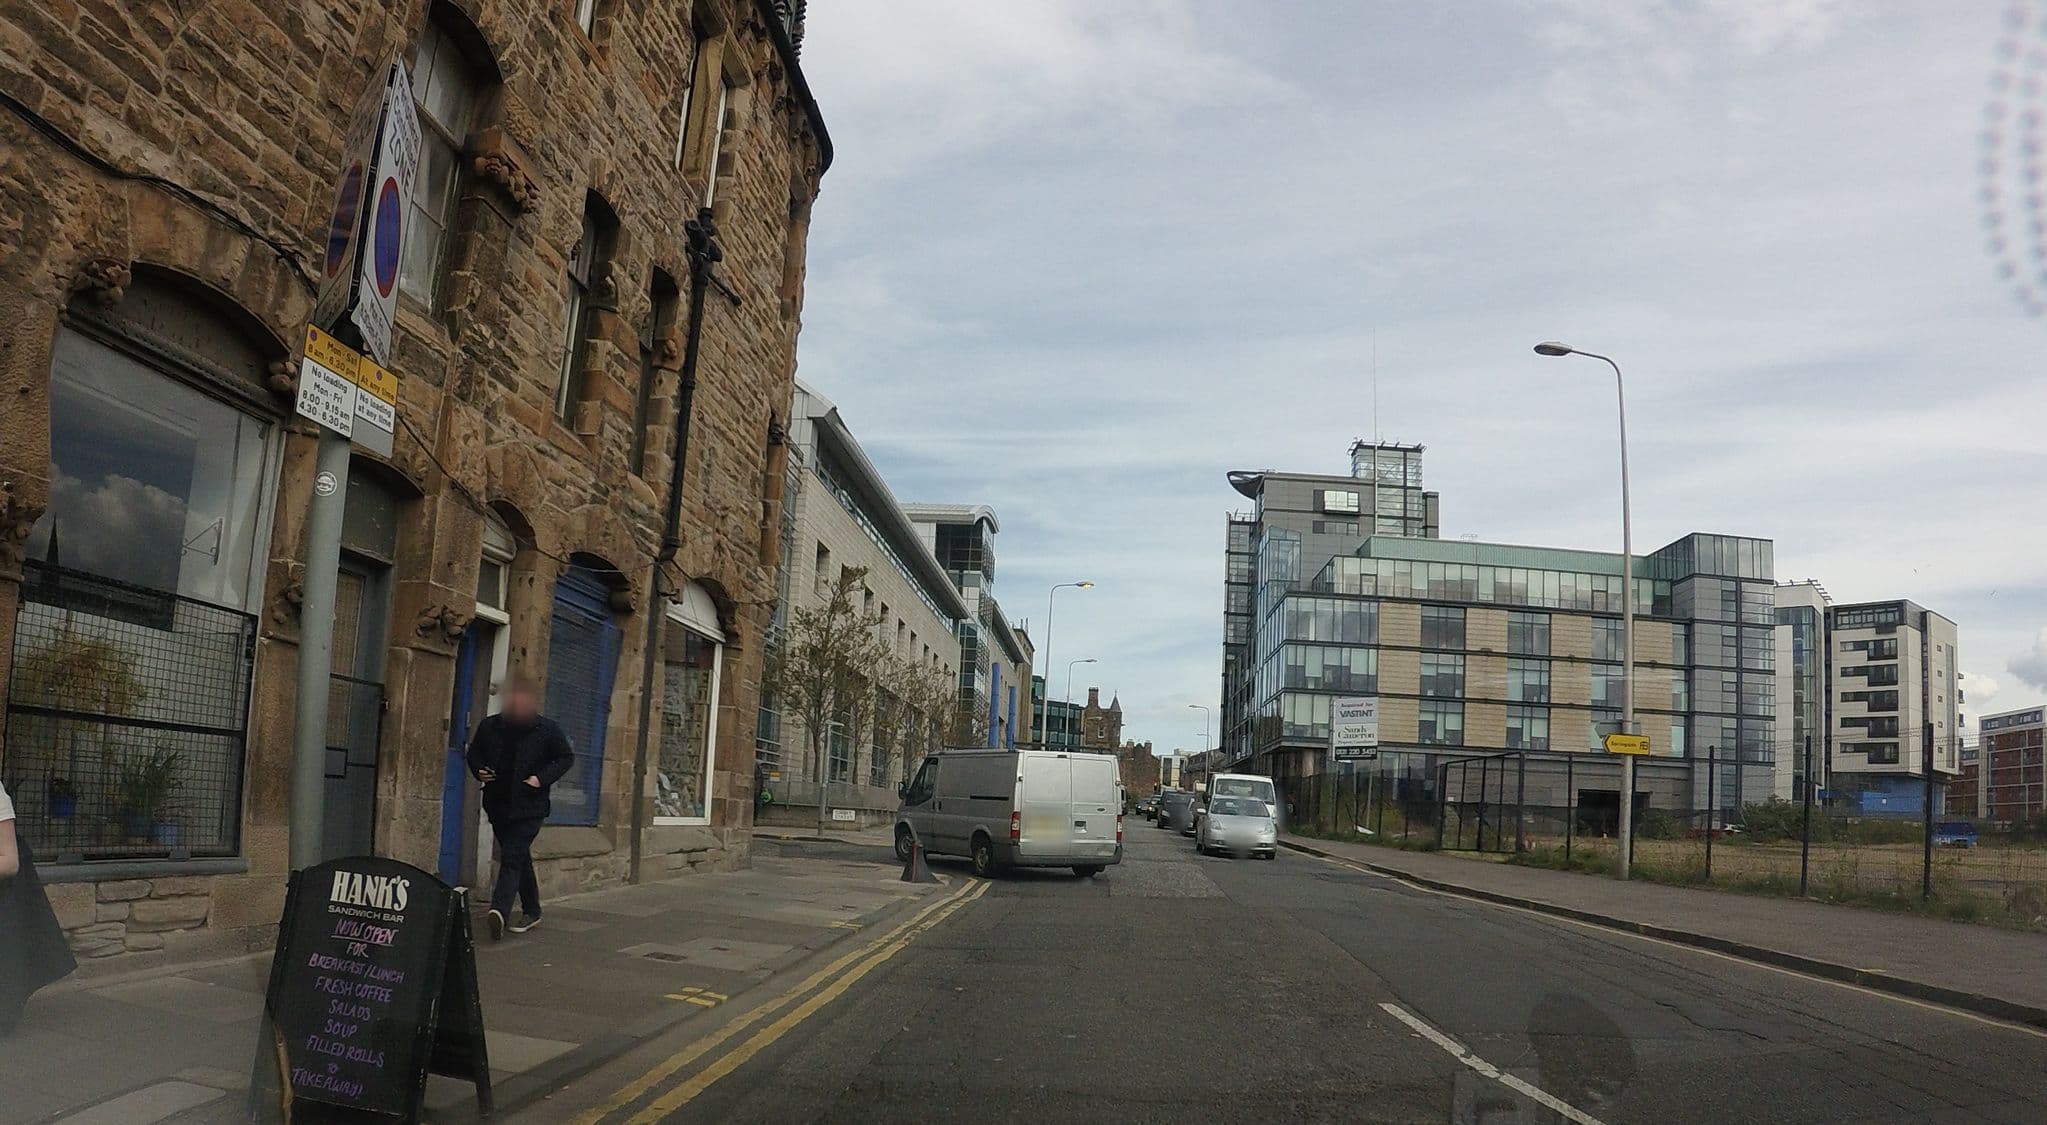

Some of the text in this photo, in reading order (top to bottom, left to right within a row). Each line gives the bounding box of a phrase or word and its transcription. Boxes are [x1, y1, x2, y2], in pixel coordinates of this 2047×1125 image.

[389, 121, 411, 198] ZONE
[311, 364, 348, 394] No loading
[313, 381, 329, 397] Mon
[333, 392, 343, 404] Fri
[359, 391, 369, 404] No
[299, 400, 318, 416] 4.30
[321, 411, 339, 427] 6.30
[339, 422, 350, 433] pm
[302, 389, 321, 406] 8.00
[325, 401, 340, 416] 9.15
[340, 410, 350, 421] am
[1339, 709, 1374, 718] VASTINT
[1337, 731, 1375, 739] Cameron
[330, 870, 410, 912] HANK'S
[327, 904, 405, 924] SANDWICH BAR
[335, 919, 400, 945] NOW OPEN
[346, 942, 369, 958] FOR
[313, 976, 393, 1003] FRESH COFFEE
[328, 999, 371, 1021] SALADS
[323, 1018, 358, 1038] SOUP
[306, 1034, 385, 1068] FILLED ROLLS
